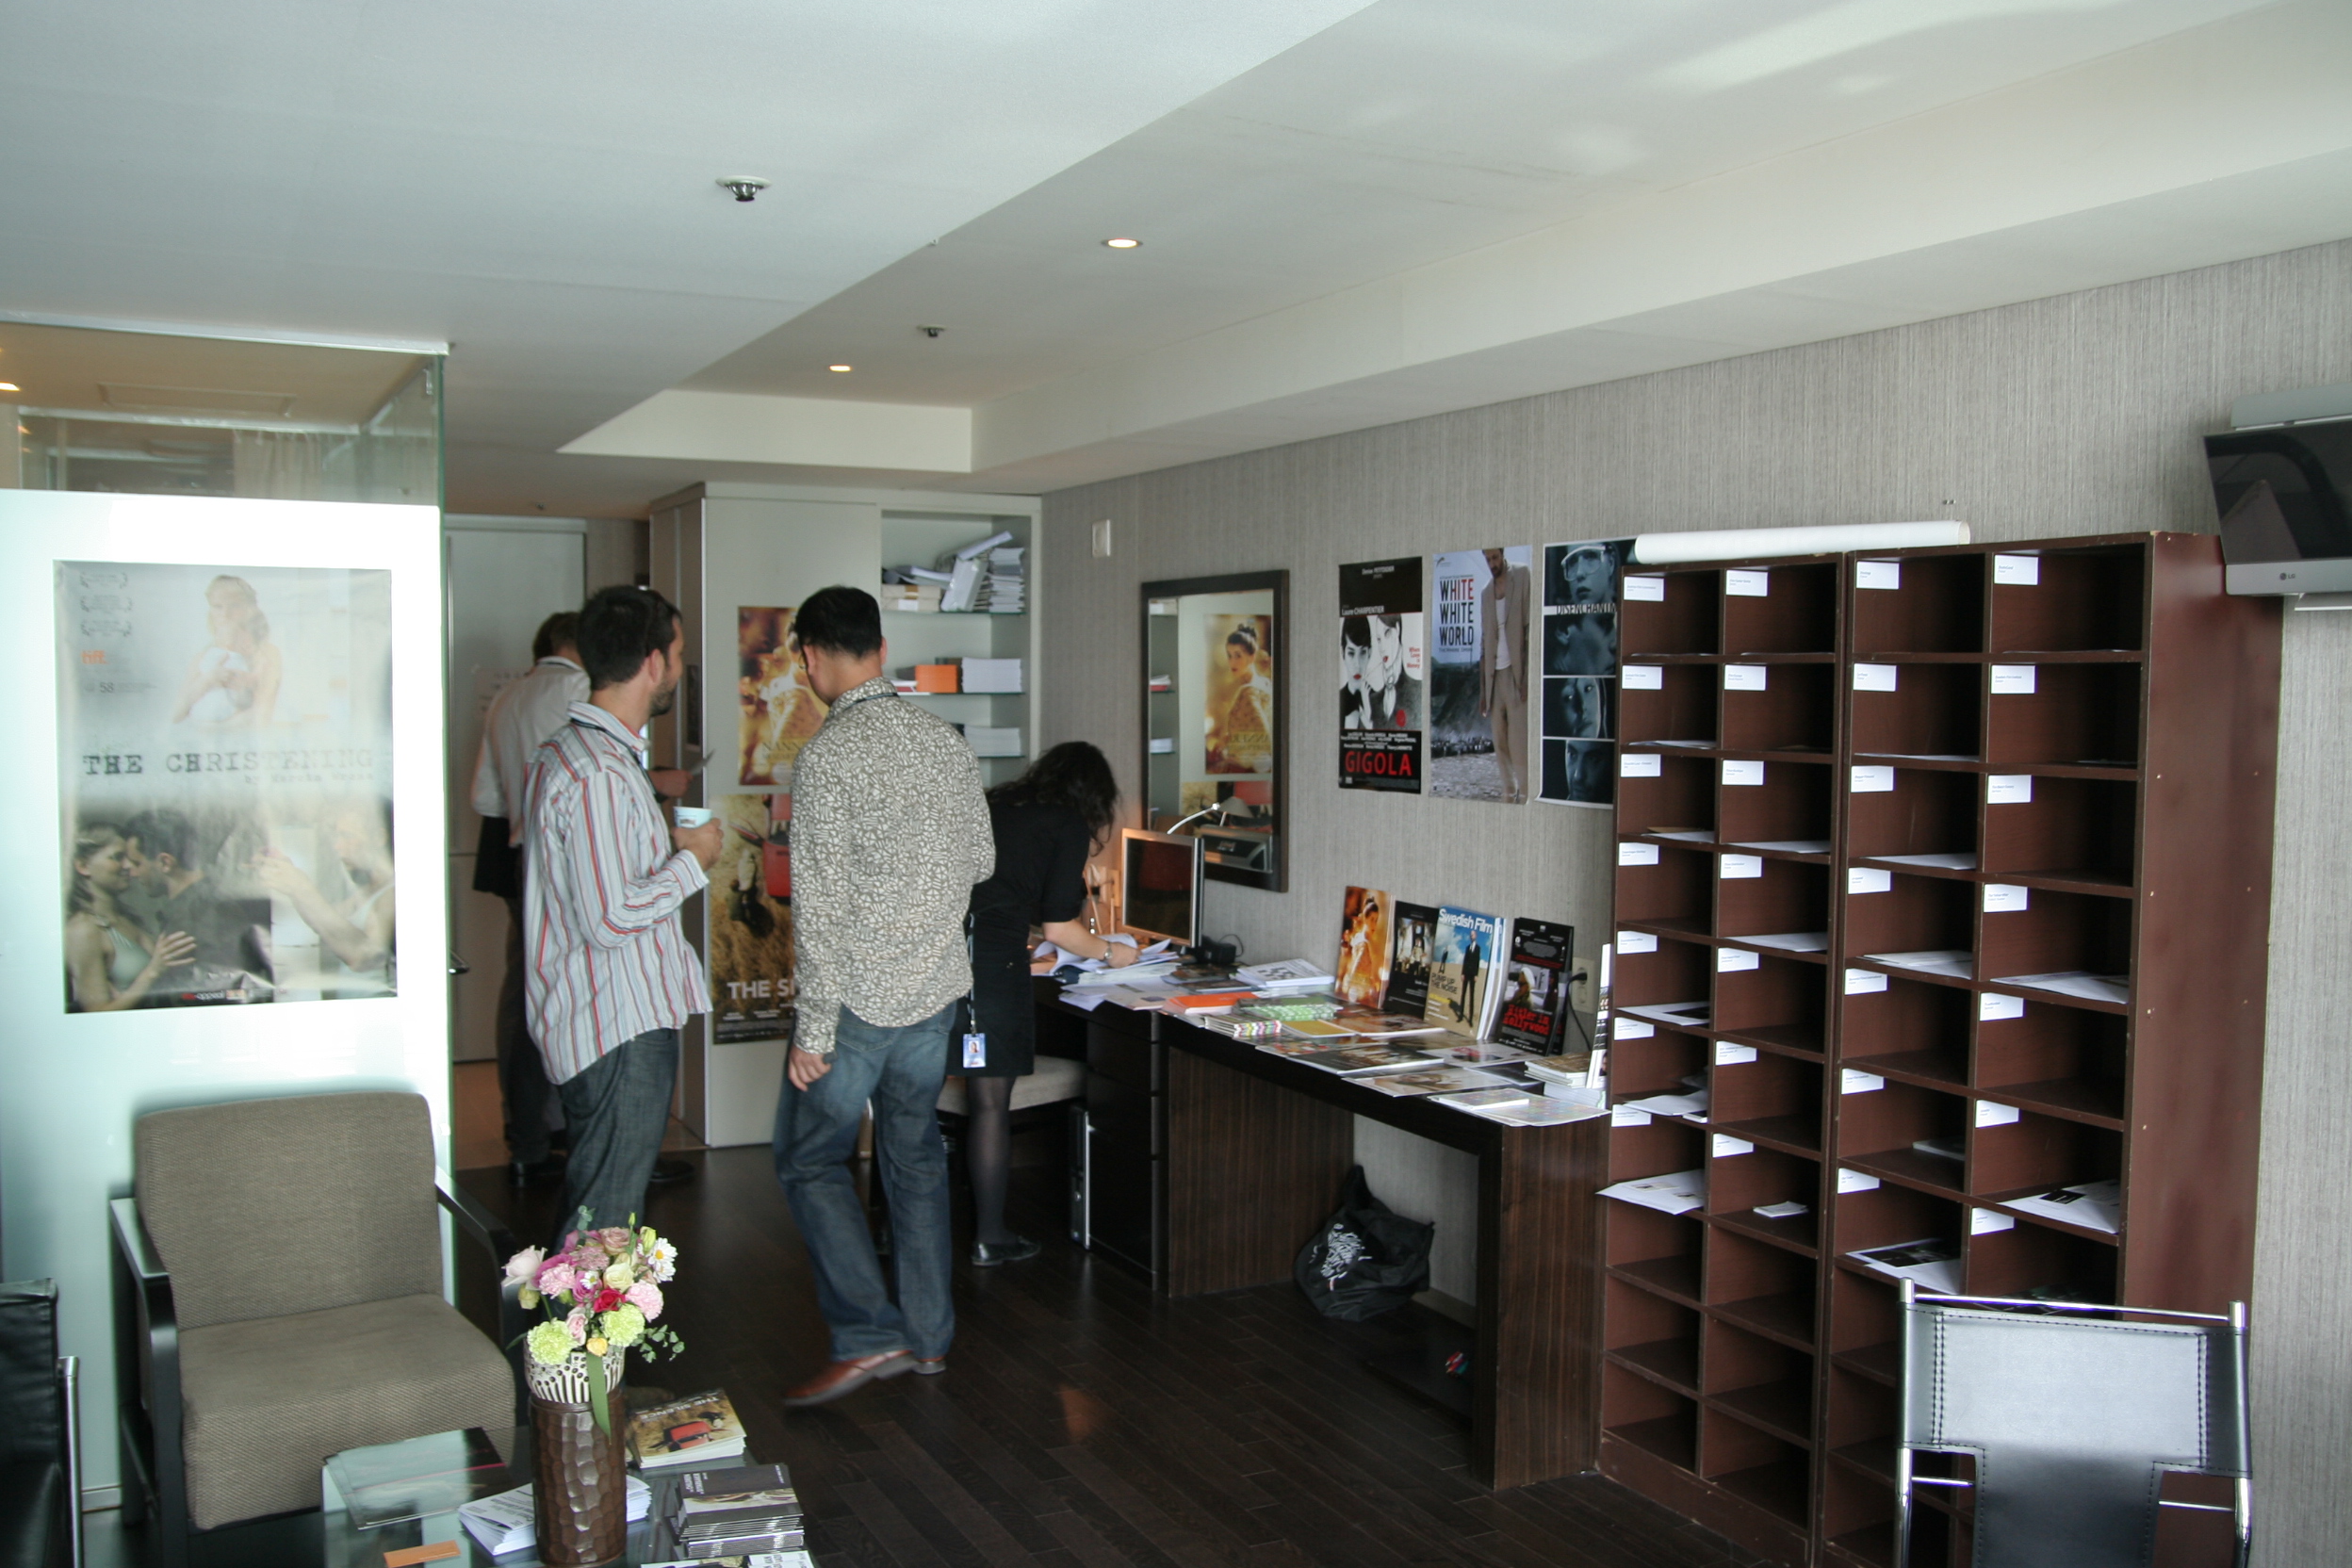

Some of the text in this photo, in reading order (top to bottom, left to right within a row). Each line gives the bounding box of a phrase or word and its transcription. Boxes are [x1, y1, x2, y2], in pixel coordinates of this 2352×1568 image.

[1440, 578, 1474, 601] WHITE
[1440, 602, 1474, 625] WHITE
[1440, 626, 1474, 646] WORLD
[83, 749, 372, 775] THE CHRISTENING
[1345, 750, 1413, 776] GIGOLA
[1439, 908, 1494, 934] Swedish Film
[1431, 972, 1446, 983] PUMP
[1441, 983, 1458, 994] NOISE
[727, 980, 771, 999] THE
[641, 1396, 719, 1420] THE SILENCE
